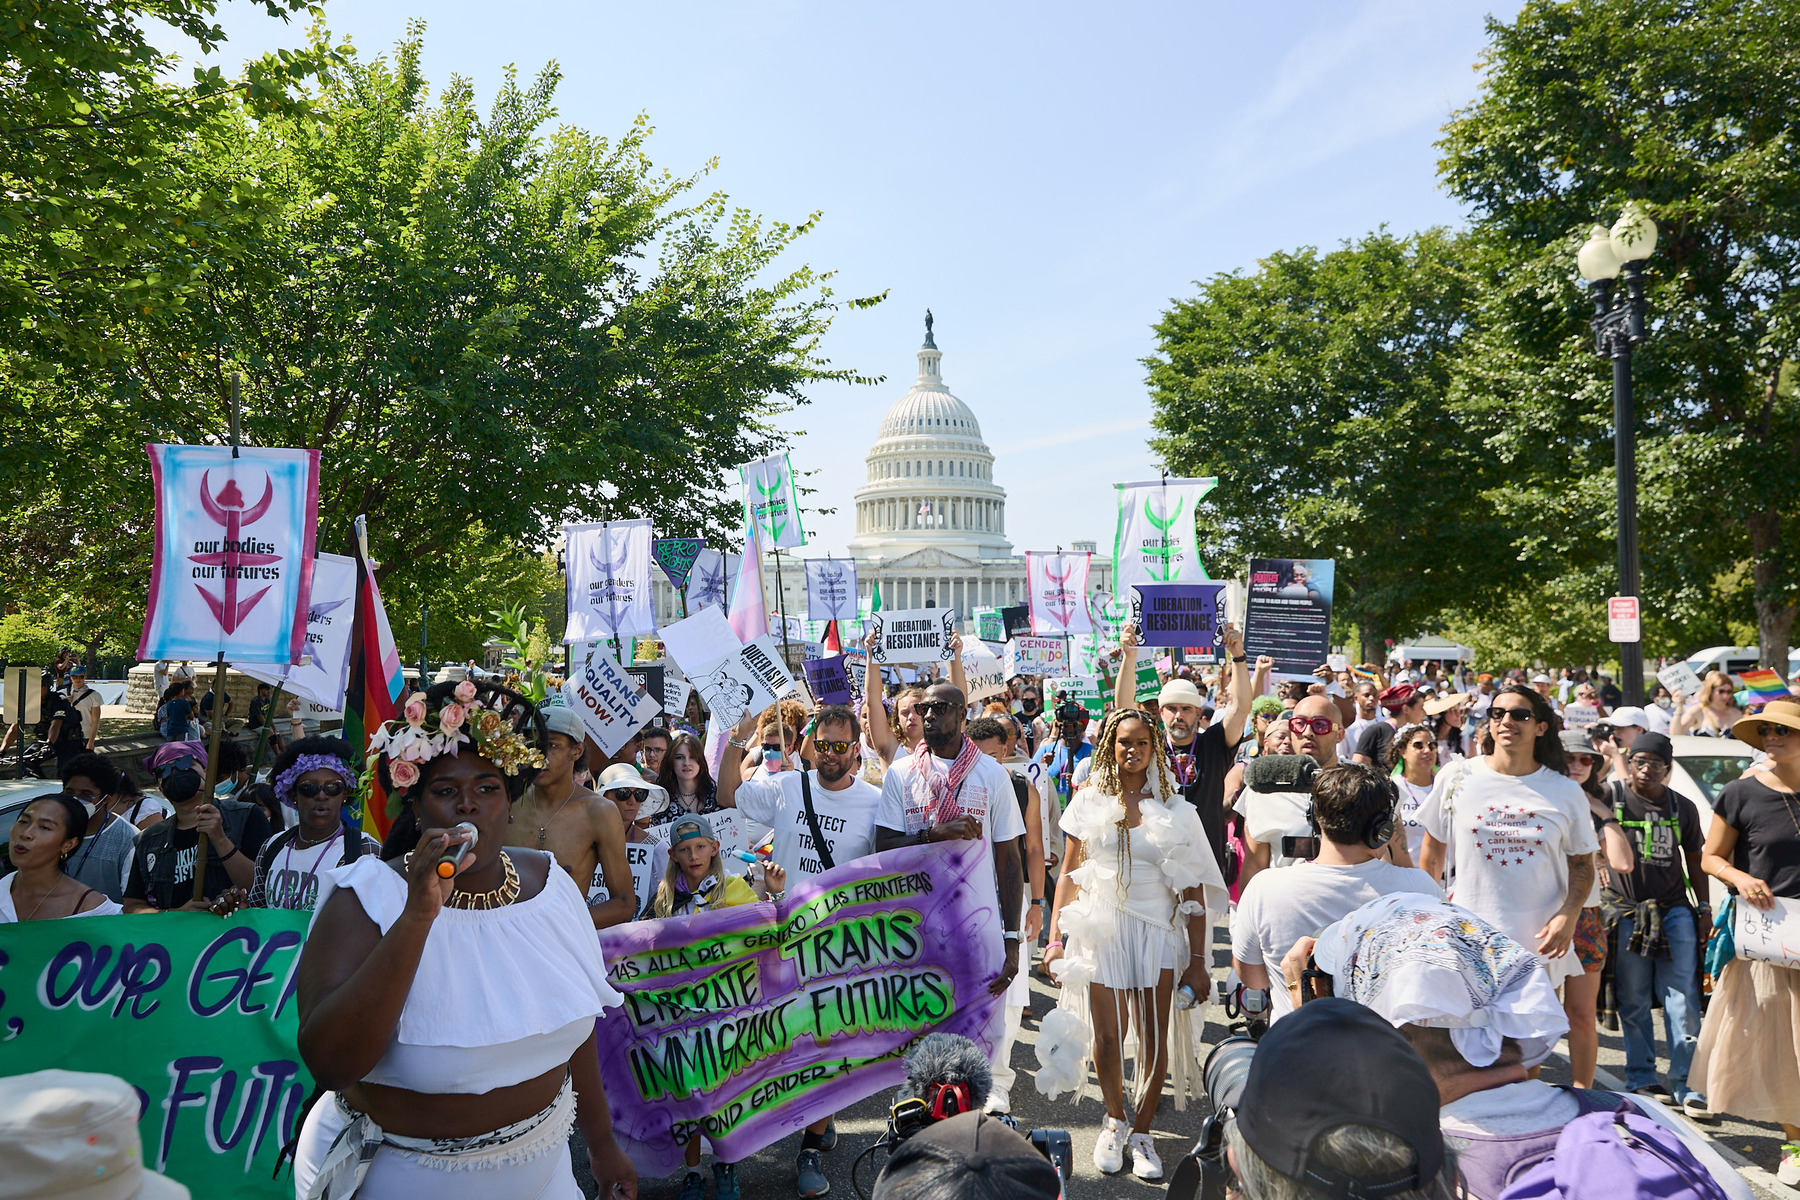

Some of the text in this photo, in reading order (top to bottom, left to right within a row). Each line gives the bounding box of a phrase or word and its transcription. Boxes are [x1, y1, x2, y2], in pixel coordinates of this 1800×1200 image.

[193, 536, 275, 555] our bodies
[656, 541, 699, 556] REPRO
[1143, 538, 1159, 547] our
[1143, 554, 1158, 563] our
[192, 561, 280, 580] our futures
[589, 577, 635, 591] our genders
[590, 593, 633, 605] our futures
[1153, 597, 1202, 612] LIBERATION
[891, 619, 932, 633] LIBERATION
[1146, 613, 1212, 632] RESISTANCE
[886, 632, 941, 650] RESISTANCE
[1019, 639, 1062, 650] GENDER
[740, 643, 789, 690] QUEER AS IN
[1020, 665, 1060, 674] everyone
[598, 658, 641, 707] TRANS
[1060, 680, 1084, 688] OUR
[584, 662, 640, 728] EQUALITY
[576, 684, 615, 727] NOW!
[967, 807, 986, 817] KIDS
[1497, 810, 1516, 820] The
[1485, 820, 1528, 829] supreme
[1494, 829, 1520, 837] court
[1491, 847, 1506, 856] my
[799, 856, 824, 875] KIDS
[647, 946, 695, 973] ALLÁ
[697, 941, 732, 961] DEL
[743, 914, 806, 948] GÉNERO
[809, 902, 820, 920] Y
[823, 891, 849, 913] LAS
[854, 872, 935, 903] FRONTERAS
[784, 913, 920, 978] TRANS
[36, 940, 172, 1020] OUR
[627, 960, 760, 1026] LIBERATE
[809, 972, 950, 1037] FUTURES
[629, 998, 798, 1095] IMMIGRANT
[751, 1065, 835, 1109] GENDER
